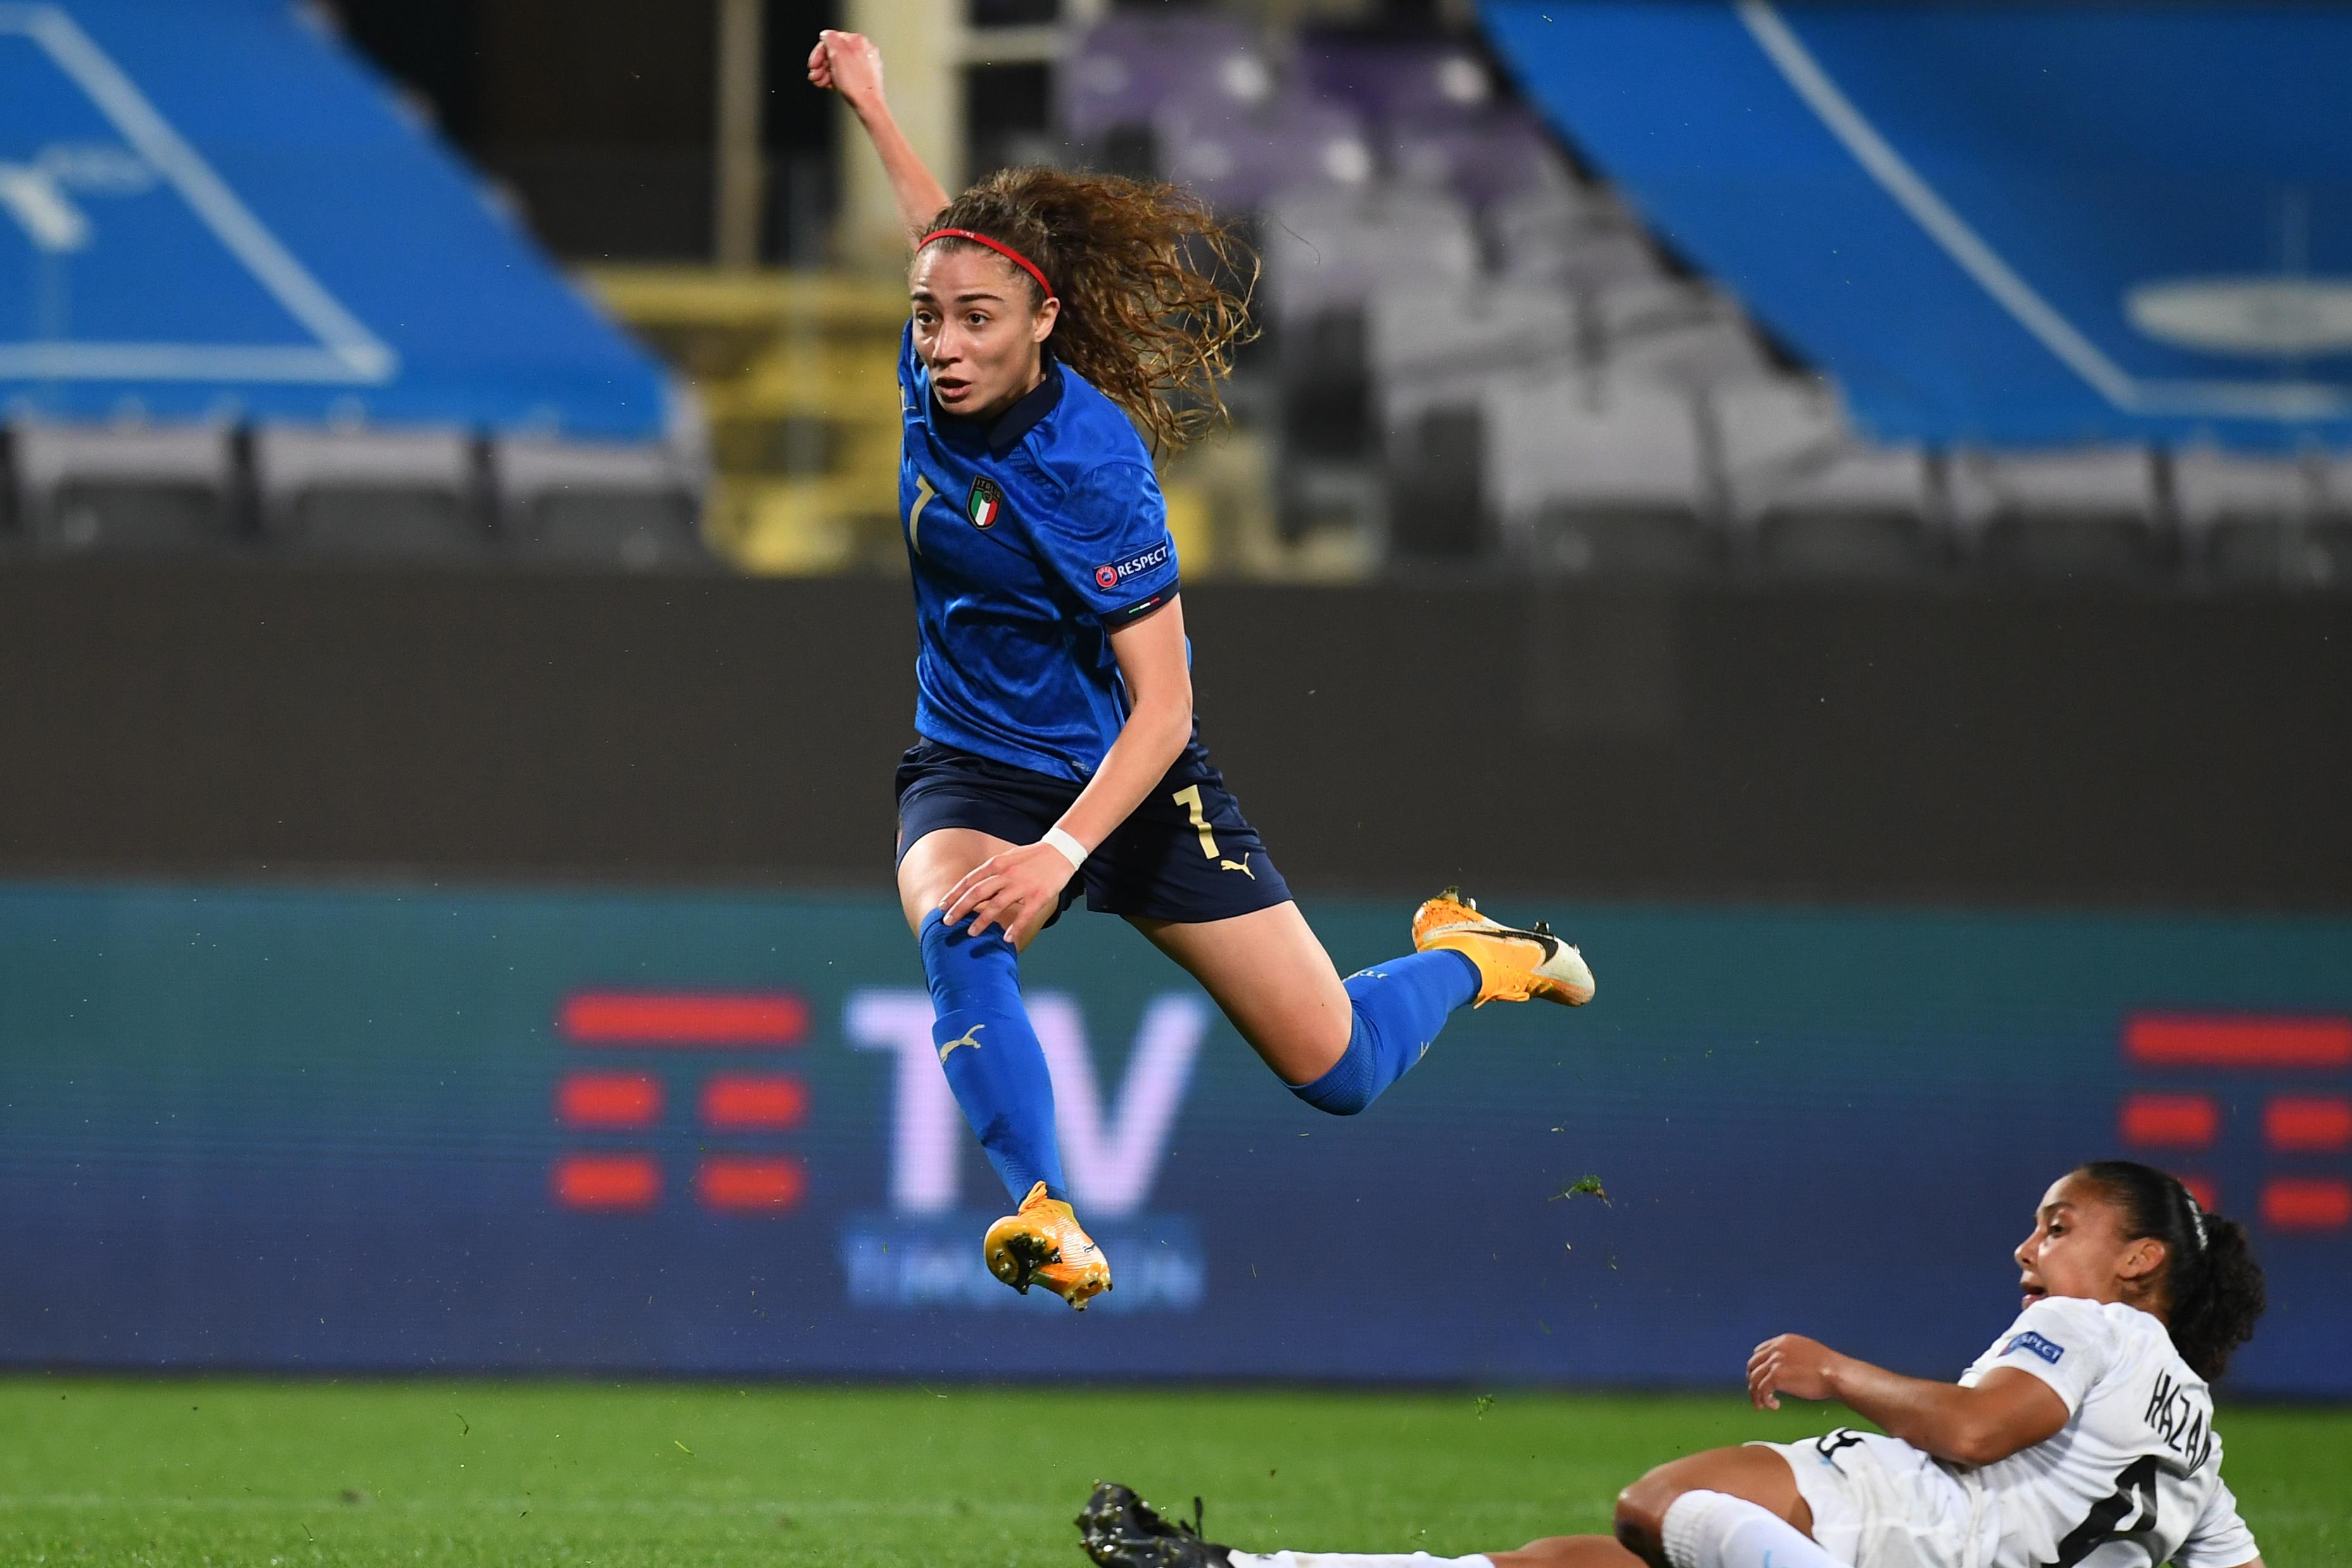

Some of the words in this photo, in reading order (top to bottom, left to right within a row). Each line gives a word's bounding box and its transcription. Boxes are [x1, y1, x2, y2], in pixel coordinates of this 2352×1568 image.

[909, 474, 935, 555] 7
[1117, 546, 1167, 578] RESPECT
[1172, 784, 1220, 859] 7
[845, 987, 1205, 1214] TV
